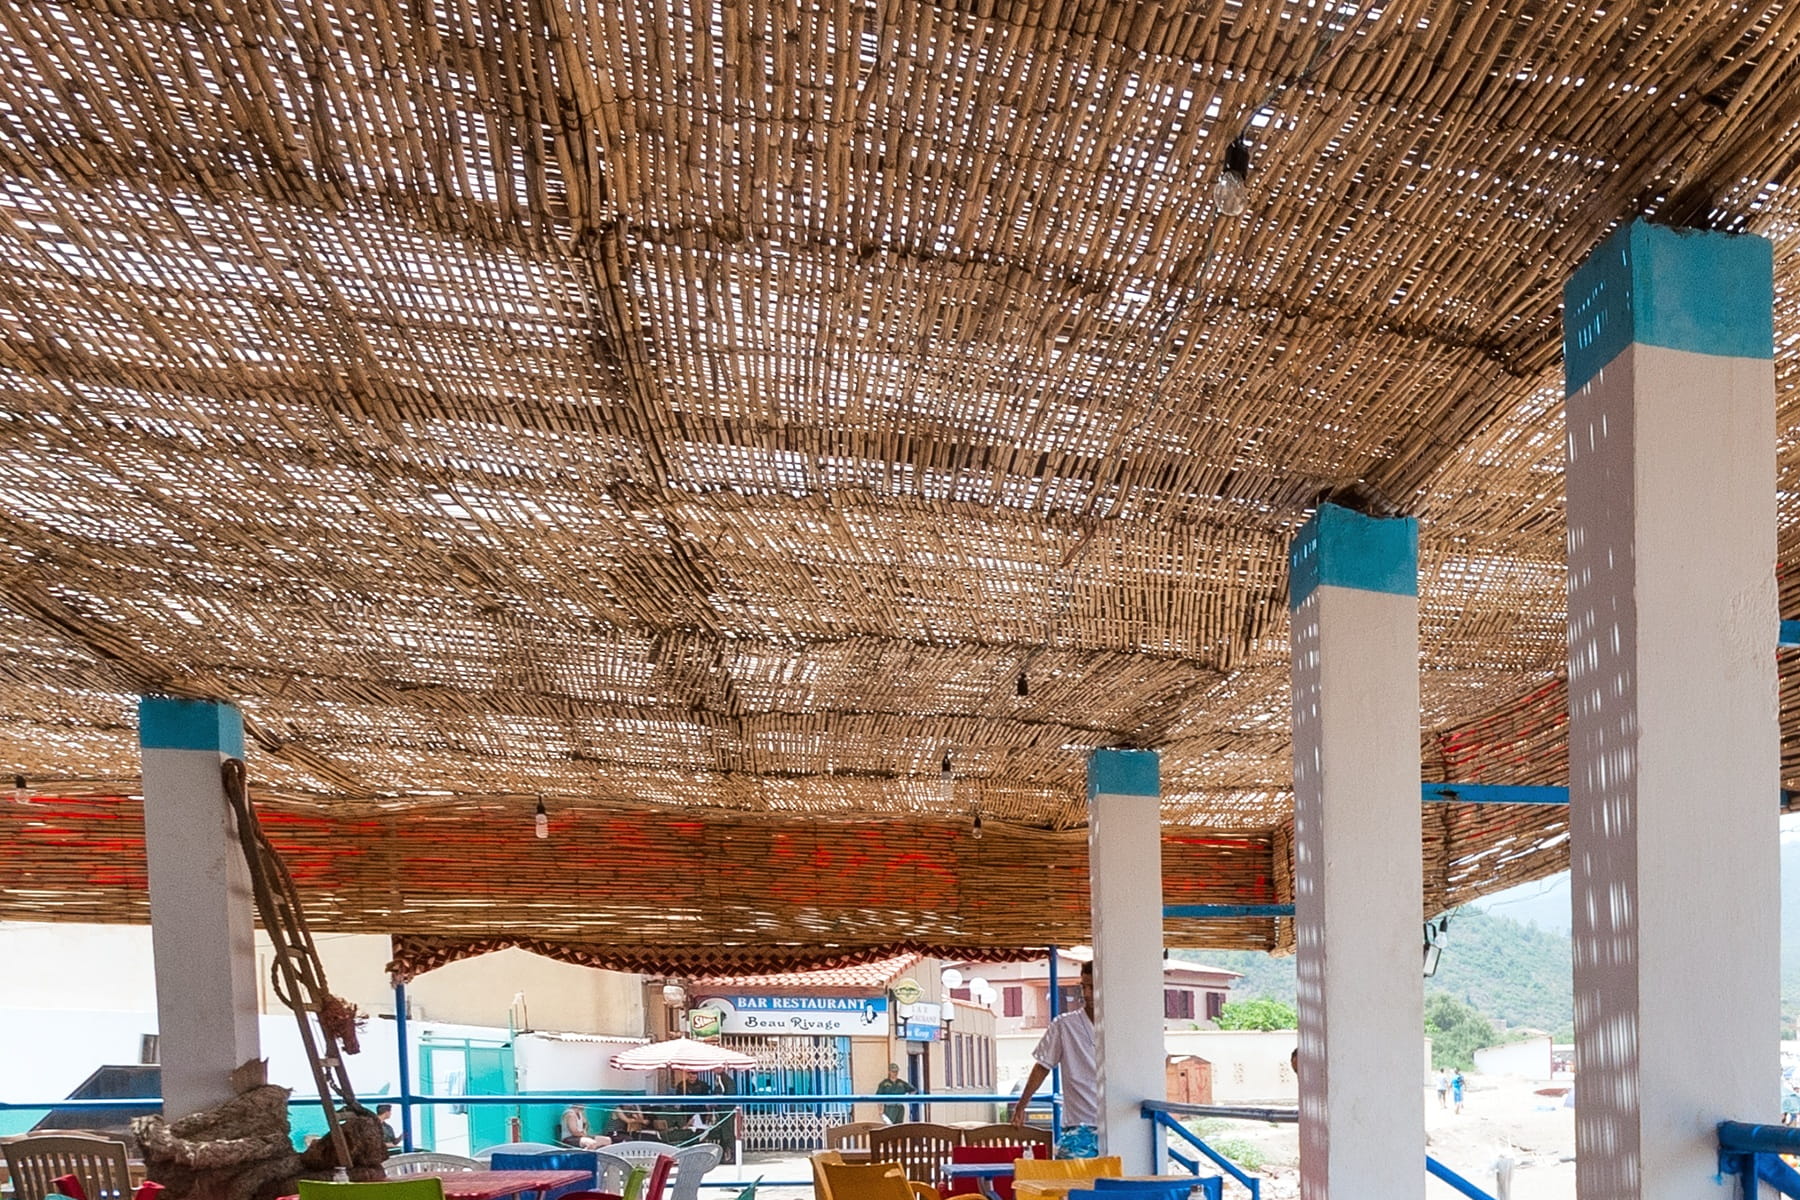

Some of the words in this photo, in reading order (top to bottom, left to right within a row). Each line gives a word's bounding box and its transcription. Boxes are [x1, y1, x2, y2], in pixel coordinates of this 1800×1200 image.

[737, 998, 768, 1008] BAR
[772, 998, 866, 1009] RESTAURANT
[744, 1016, 785, 1028] Beau
[790, 1016, 840, 1030] Rivage
